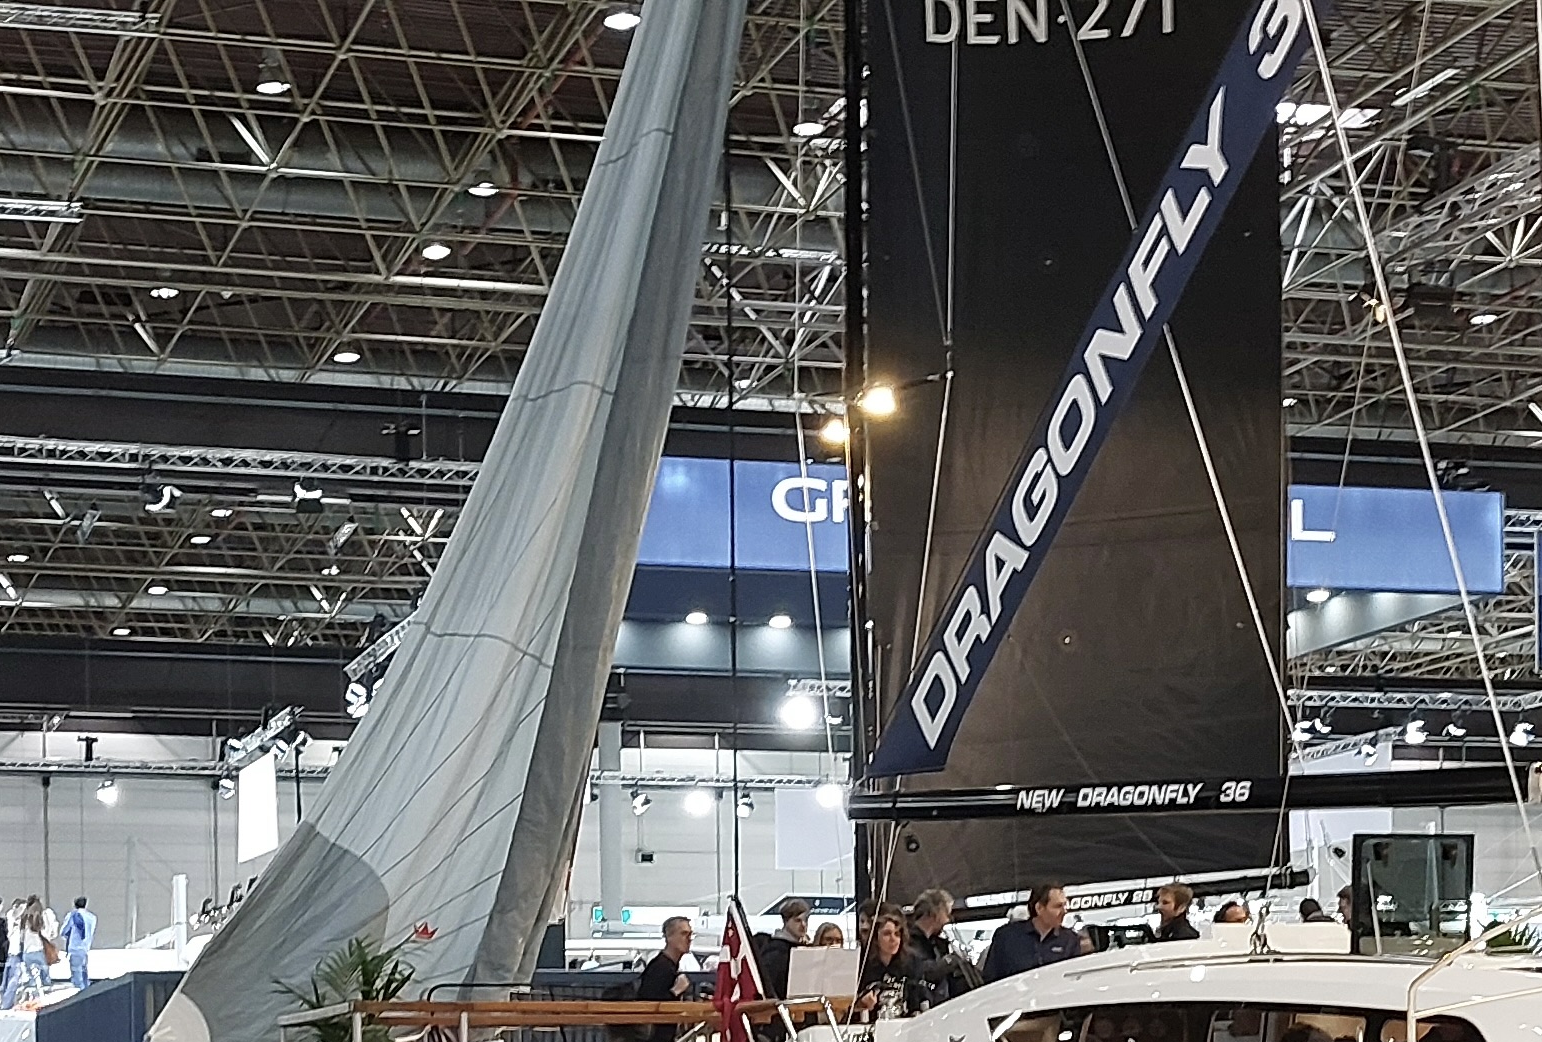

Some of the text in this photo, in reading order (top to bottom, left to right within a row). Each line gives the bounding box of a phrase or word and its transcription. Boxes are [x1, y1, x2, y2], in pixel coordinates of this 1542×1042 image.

[911, 85, 1229, 749] DRAGONFLY
[1017, 780, 1252, 811] NEW DRAGONFLY 36
